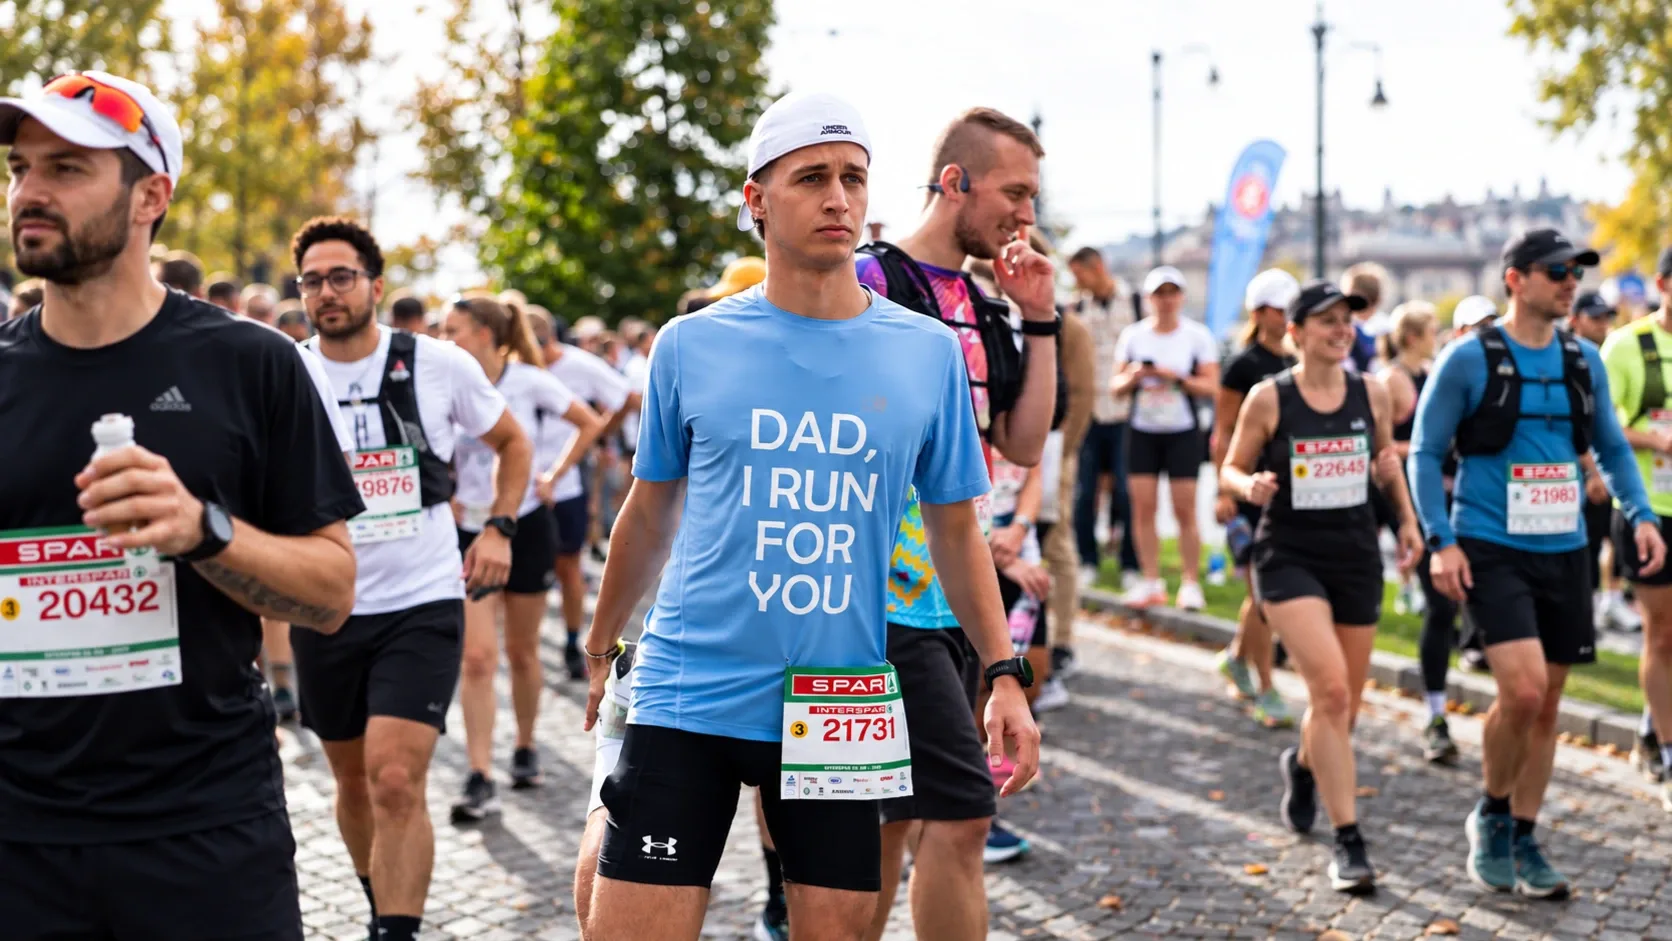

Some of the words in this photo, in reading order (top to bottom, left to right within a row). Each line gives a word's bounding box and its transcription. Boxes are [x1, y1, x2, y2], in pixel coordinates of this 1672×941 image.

[751, 408, 877, 463] DAD,
[742, 465, 752, 507] I
[769, 467, 879, 512] RUN
[755, 520, 855, 565] FOR
[5, 601, 16, 616] 3
[38, 580, 160, 622] 20432
[749, 571, 852, 615] YOU
[812, 678, 884, 692] SPAR
[794, 723, 805, 736] 3
[823, 716, 895, 742] 21731
[816, 705, 885, 714] INTERSPAR
